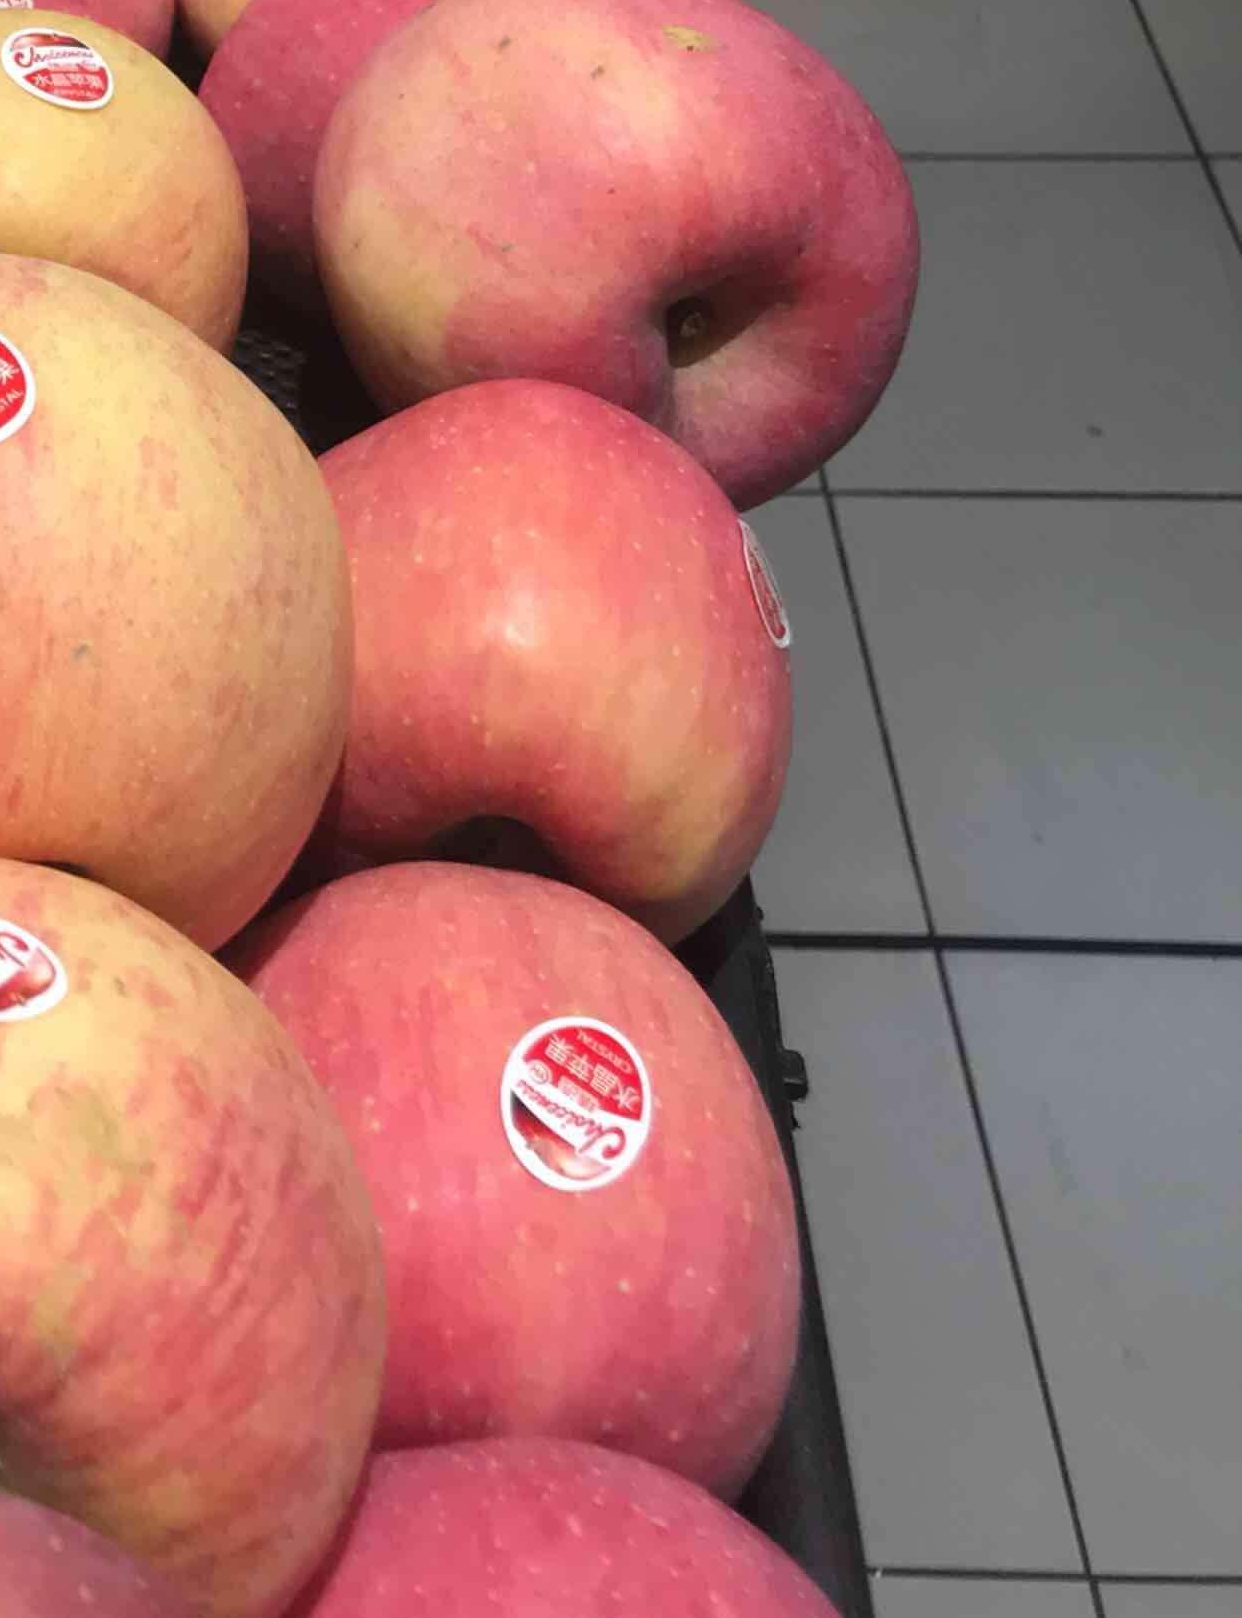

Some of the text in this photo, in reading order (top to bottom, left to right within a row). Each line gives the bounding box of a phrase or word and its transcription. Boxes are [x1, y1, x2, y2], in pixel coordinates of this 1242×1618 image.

[545, 1033, 640, 1112] 水晶苹果
[577, 1029, 631, 1073] CRYSTAL
[517, 1079, 626, 1159] Choiceness
